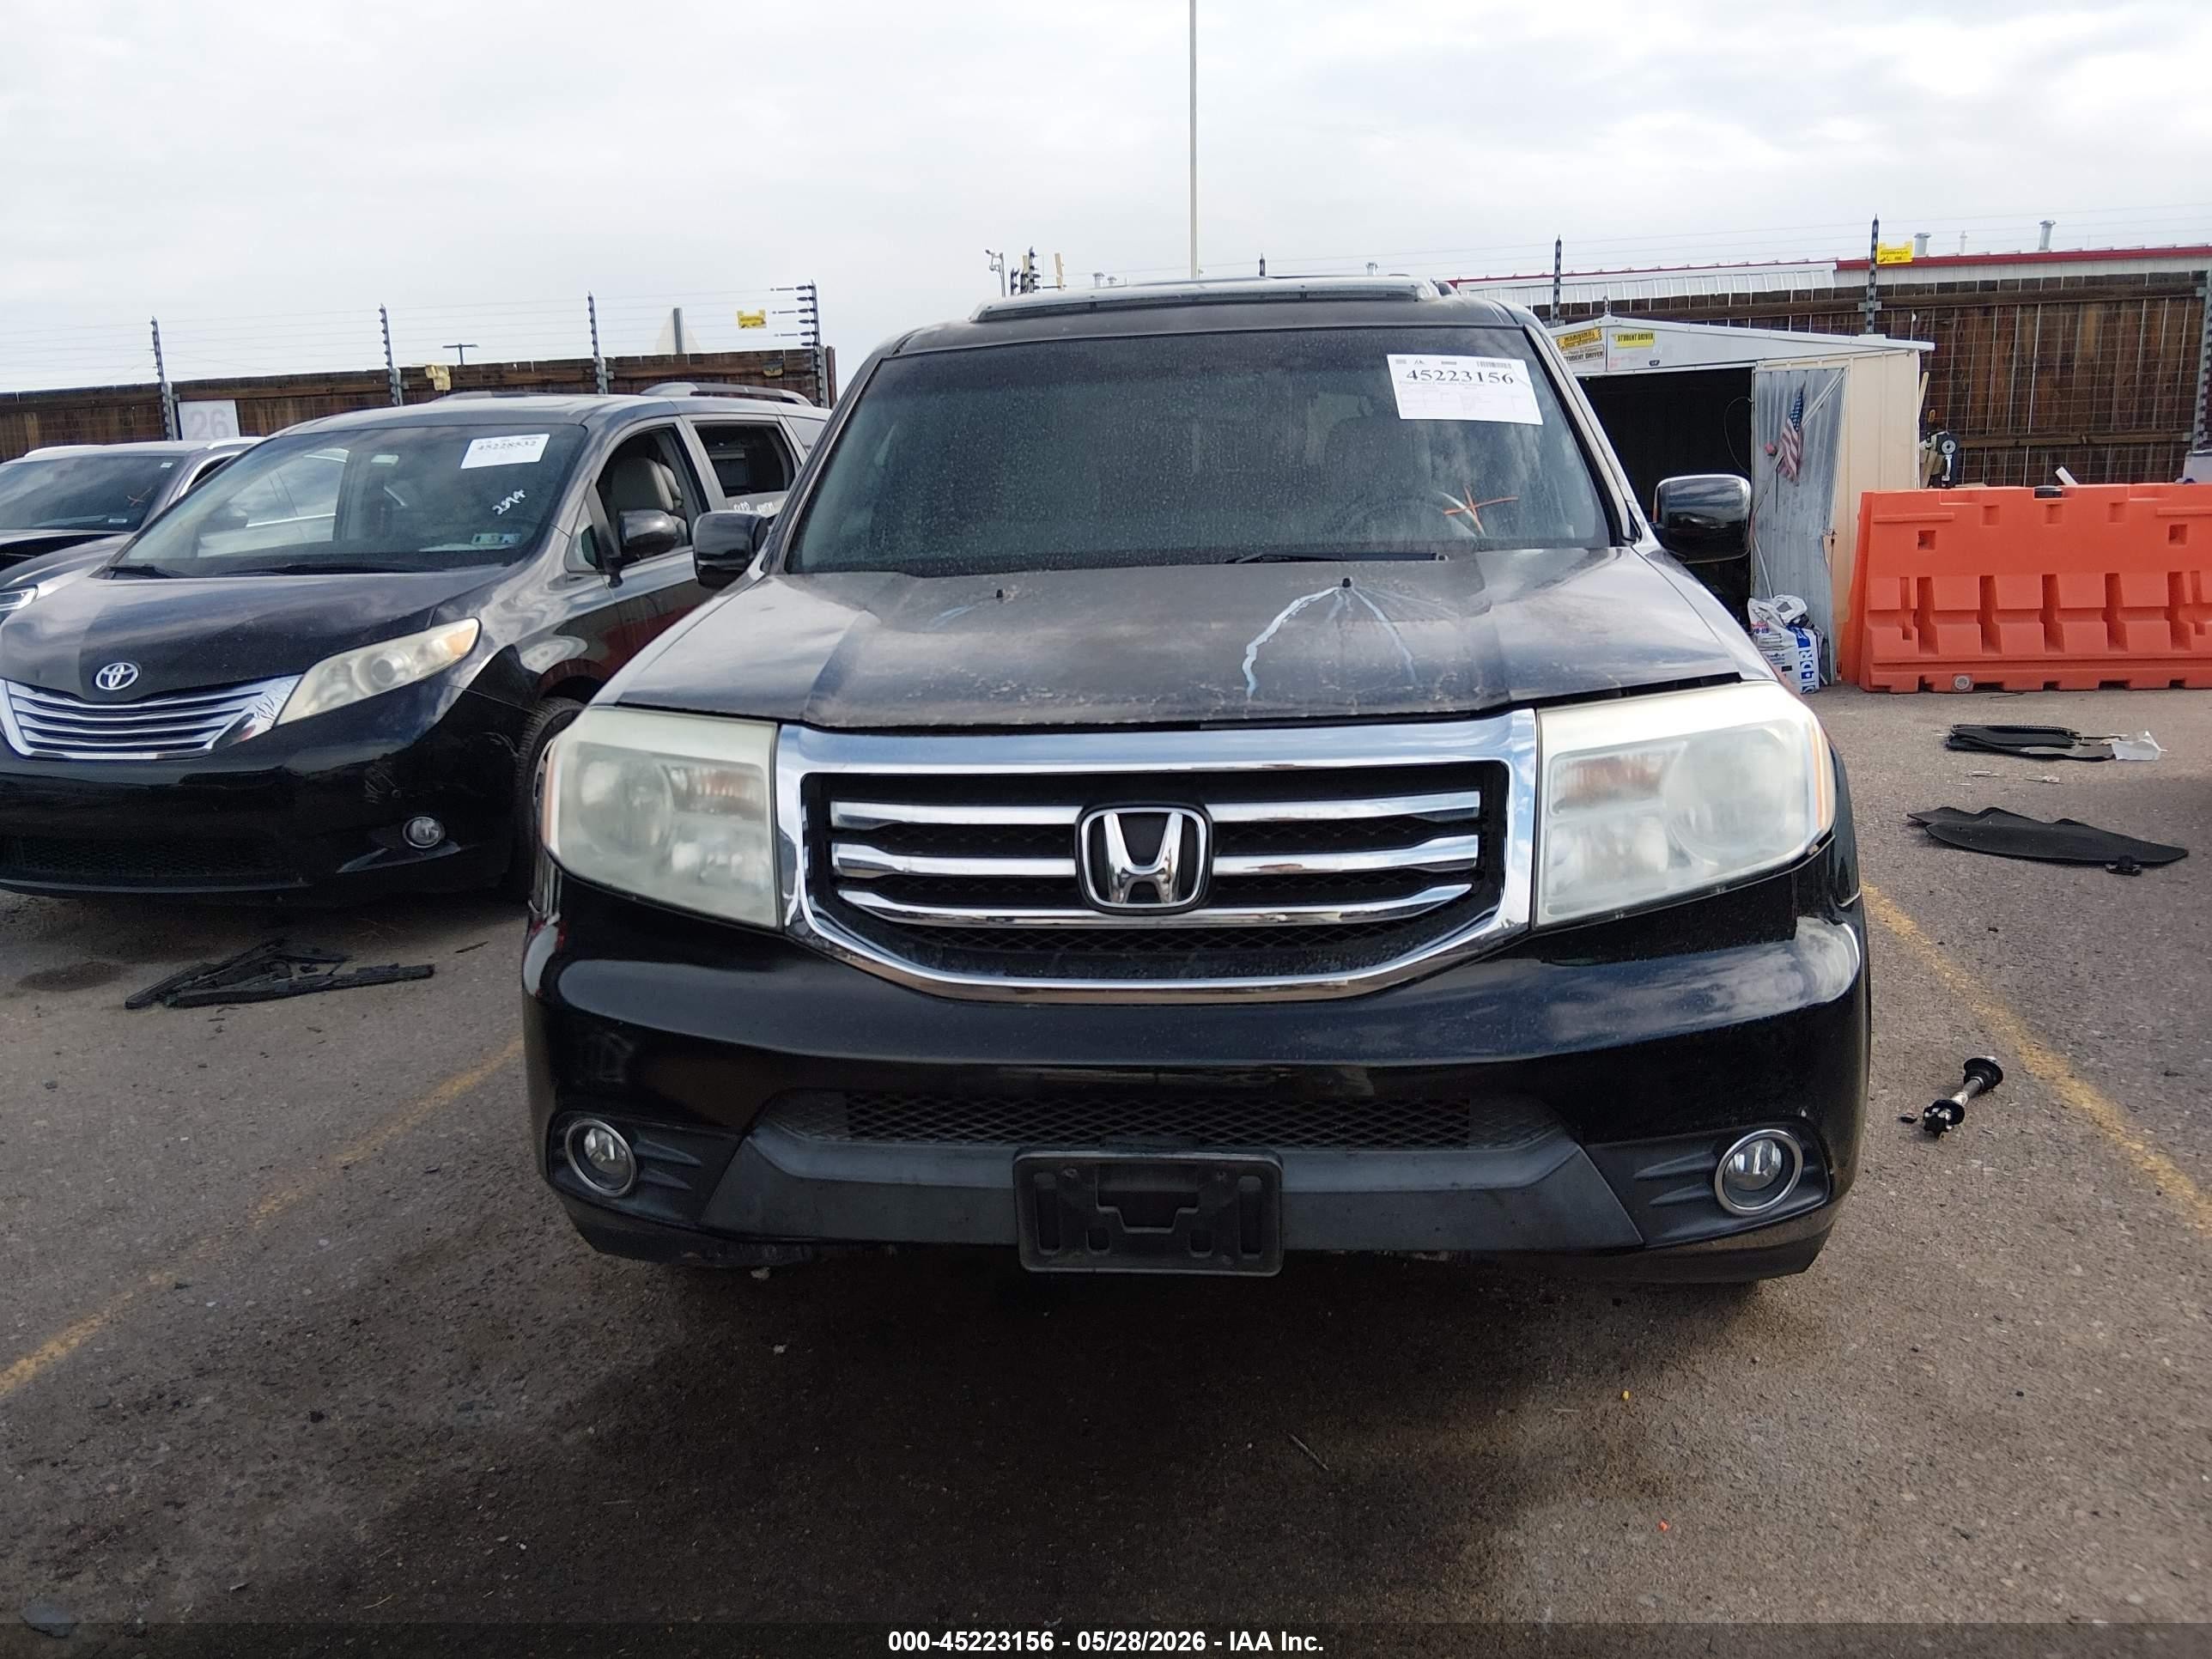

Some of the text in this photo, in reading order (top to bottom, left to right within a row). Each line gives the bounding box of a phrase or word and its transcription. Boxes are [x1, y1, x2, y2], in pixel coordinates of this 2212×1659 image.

[1618, 333, 1637, 342] STUDENT
[1407, 369, 1514, 386] 45223156
[190, 409, 229, 440] 26
